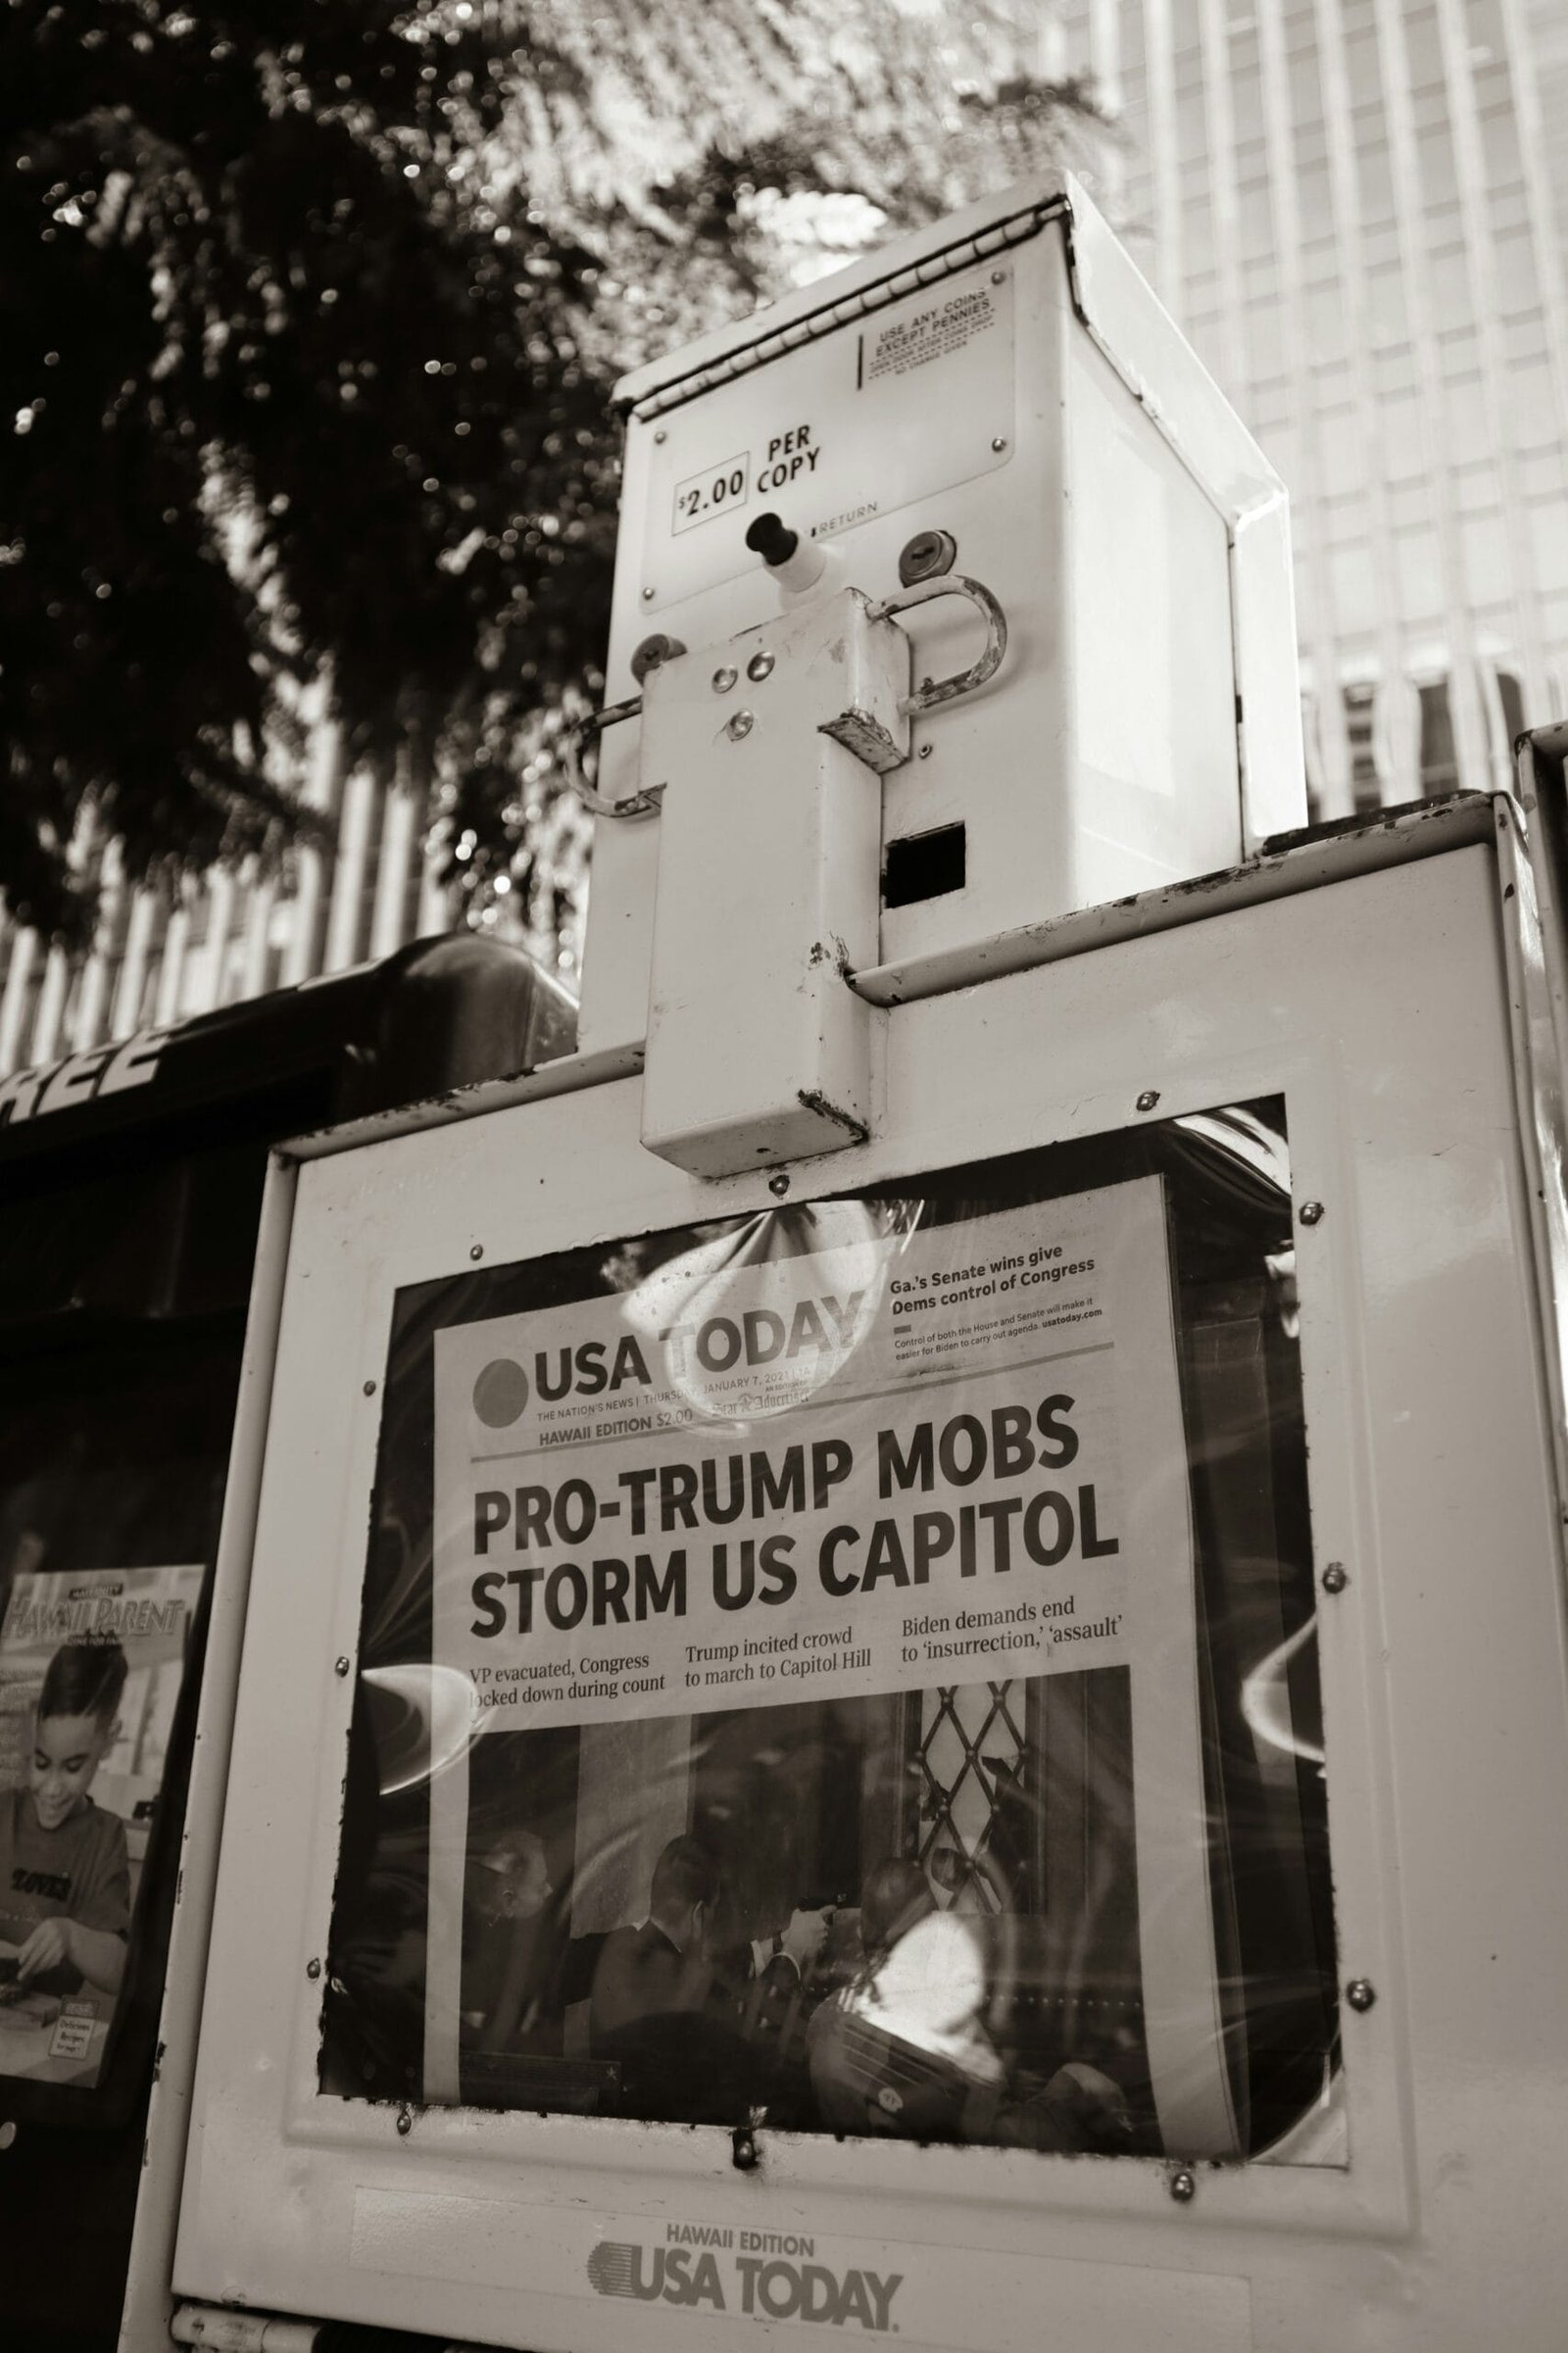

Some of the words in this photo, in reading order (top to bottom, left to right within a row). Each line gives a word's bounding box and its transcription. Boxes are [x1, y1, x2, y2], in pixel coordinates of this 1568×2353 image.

[876, 326, 926, 357] EXCEPT
[932, 298, 990, 331] PENNIES
[880, 323, 905, 342] USE
[910, 308, 938, 328] ANY
[944, 288, 986, 314] COINS
[768, 424, 810, 462] PER
[678, 469, 744, 516] $2.00
[757, 446, 820, 493] COPY
[819, 502, 878, 533] RETURN
[890, 1276, 928, 1295] Ga.'s
[932, 1263, 986, 1287] Senate
[990, 1254, 1025, 1274] wins
[1029, 1246, 1062, 1267] give
[893, 1297, 936, 1315] Dems
[941, 1280, 996, 1305] control
[1000, 1277, 1017, 1292] of
[1020, 1258, 1095, 1286] Congress
[534, 1335, 652, 1401] USA
[659, 1290, 866, 1379] TODAY
[895, 1337, 925, 1349] Control
[927, 1332, 936, 1343] of
[937, 1330, 957, 1341] both
[958, 1326, 972, 1336] the
[973, 1320, 999, 1333] House
[1000, 1316, 1015, 1326] and
[1017, 1308, 1045, 1323] Senate
[1046, 1304, 1061, 1314] will
[1062, 1299, 1085, 1312] make
[1086, 1297, 1094, 1306] it
[896, 1348, 920, 1361] easier
[921, 1347, 934, 1356] for
[936, 1341, 959, 1354] Biden
[960, 1340, 969, 1348] to
[970, 1334, 991, 1346] carry
[992, 1331, 1006, 1341] out
[1042, 1307, 1102, 1329] usatoday.com
[538, 1410, 555, 1421] THE
[558, 1402, 604, 1419] NATION'S
[606, 1397, 634, 1410] NEWS
[705, 1376, 749, 1394] JANUARY
[753, 1375, 762, 1387] 7,
[539, 1426, 591, 1446] HAWAII
[596, 1416, 652, 1438] EDITION
[657, 1408, 693, 1428] $2.00
[473, 1439, 853, 1555] PRO-TRUMP
[877, 1394, 1079, 1499] MOBS
[469, 1549, 686, 1639] STORM
[712, 1535, 797, 1611] US
[819, 1484, 1119, 1596] CAPITOL
[95, 1598, 186, 1635] PARENT
[902, 1615, 950, 1637] Biden
[956, 1602, 1037, 1630] demands
[1042, 1595, 1075, 1618] end
[685, 1644, 739, 1663] Trump
[744, 1633, 799, 1656] incited
[803, 1626, 853, 1648] crowd
[902, 1644, 918, 1662] to
[470, 1668, 492, 1684] VP
[495, 1659, 575, 1683] evacuated,
[580, 1654, 650, 1675] Congress
[522, 1685, 564, 1703] down
[568, 1680, 618, 1699] during
[622, 1675, 666, 1693] count
[685, 1671, 700, 1688] to
[705, 1663, 755, 1686] march
[760, 1663, 775, 1679] to
[780, 1652, 837, 1678] Capitol
[843, 1648, 871, 1669] Hill
[666, 2223, 734, 2249] HAWAII
[740, 2230, 814, 2257] EDITION
[631, 2245, 726, 2311] USA
